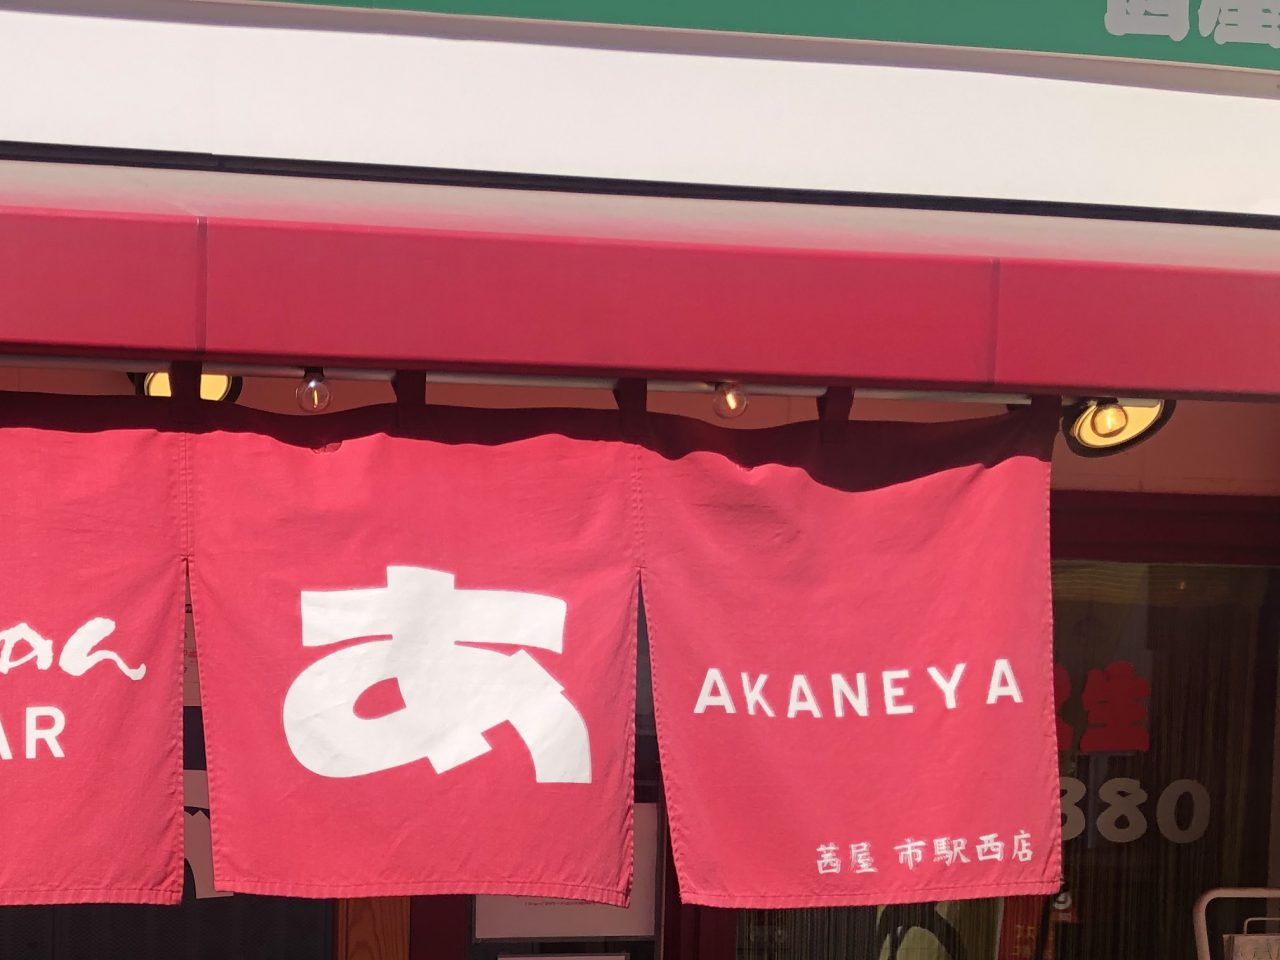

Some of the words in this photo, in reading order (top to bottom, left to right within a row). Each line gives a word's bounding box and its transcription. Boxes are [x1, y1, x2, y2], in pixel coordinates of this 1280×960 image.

[282, 565, 592, 784] あ
[693, 658, 1024, 720] AKANEYA
[893, 829, 1033, 870] 市駅西店
